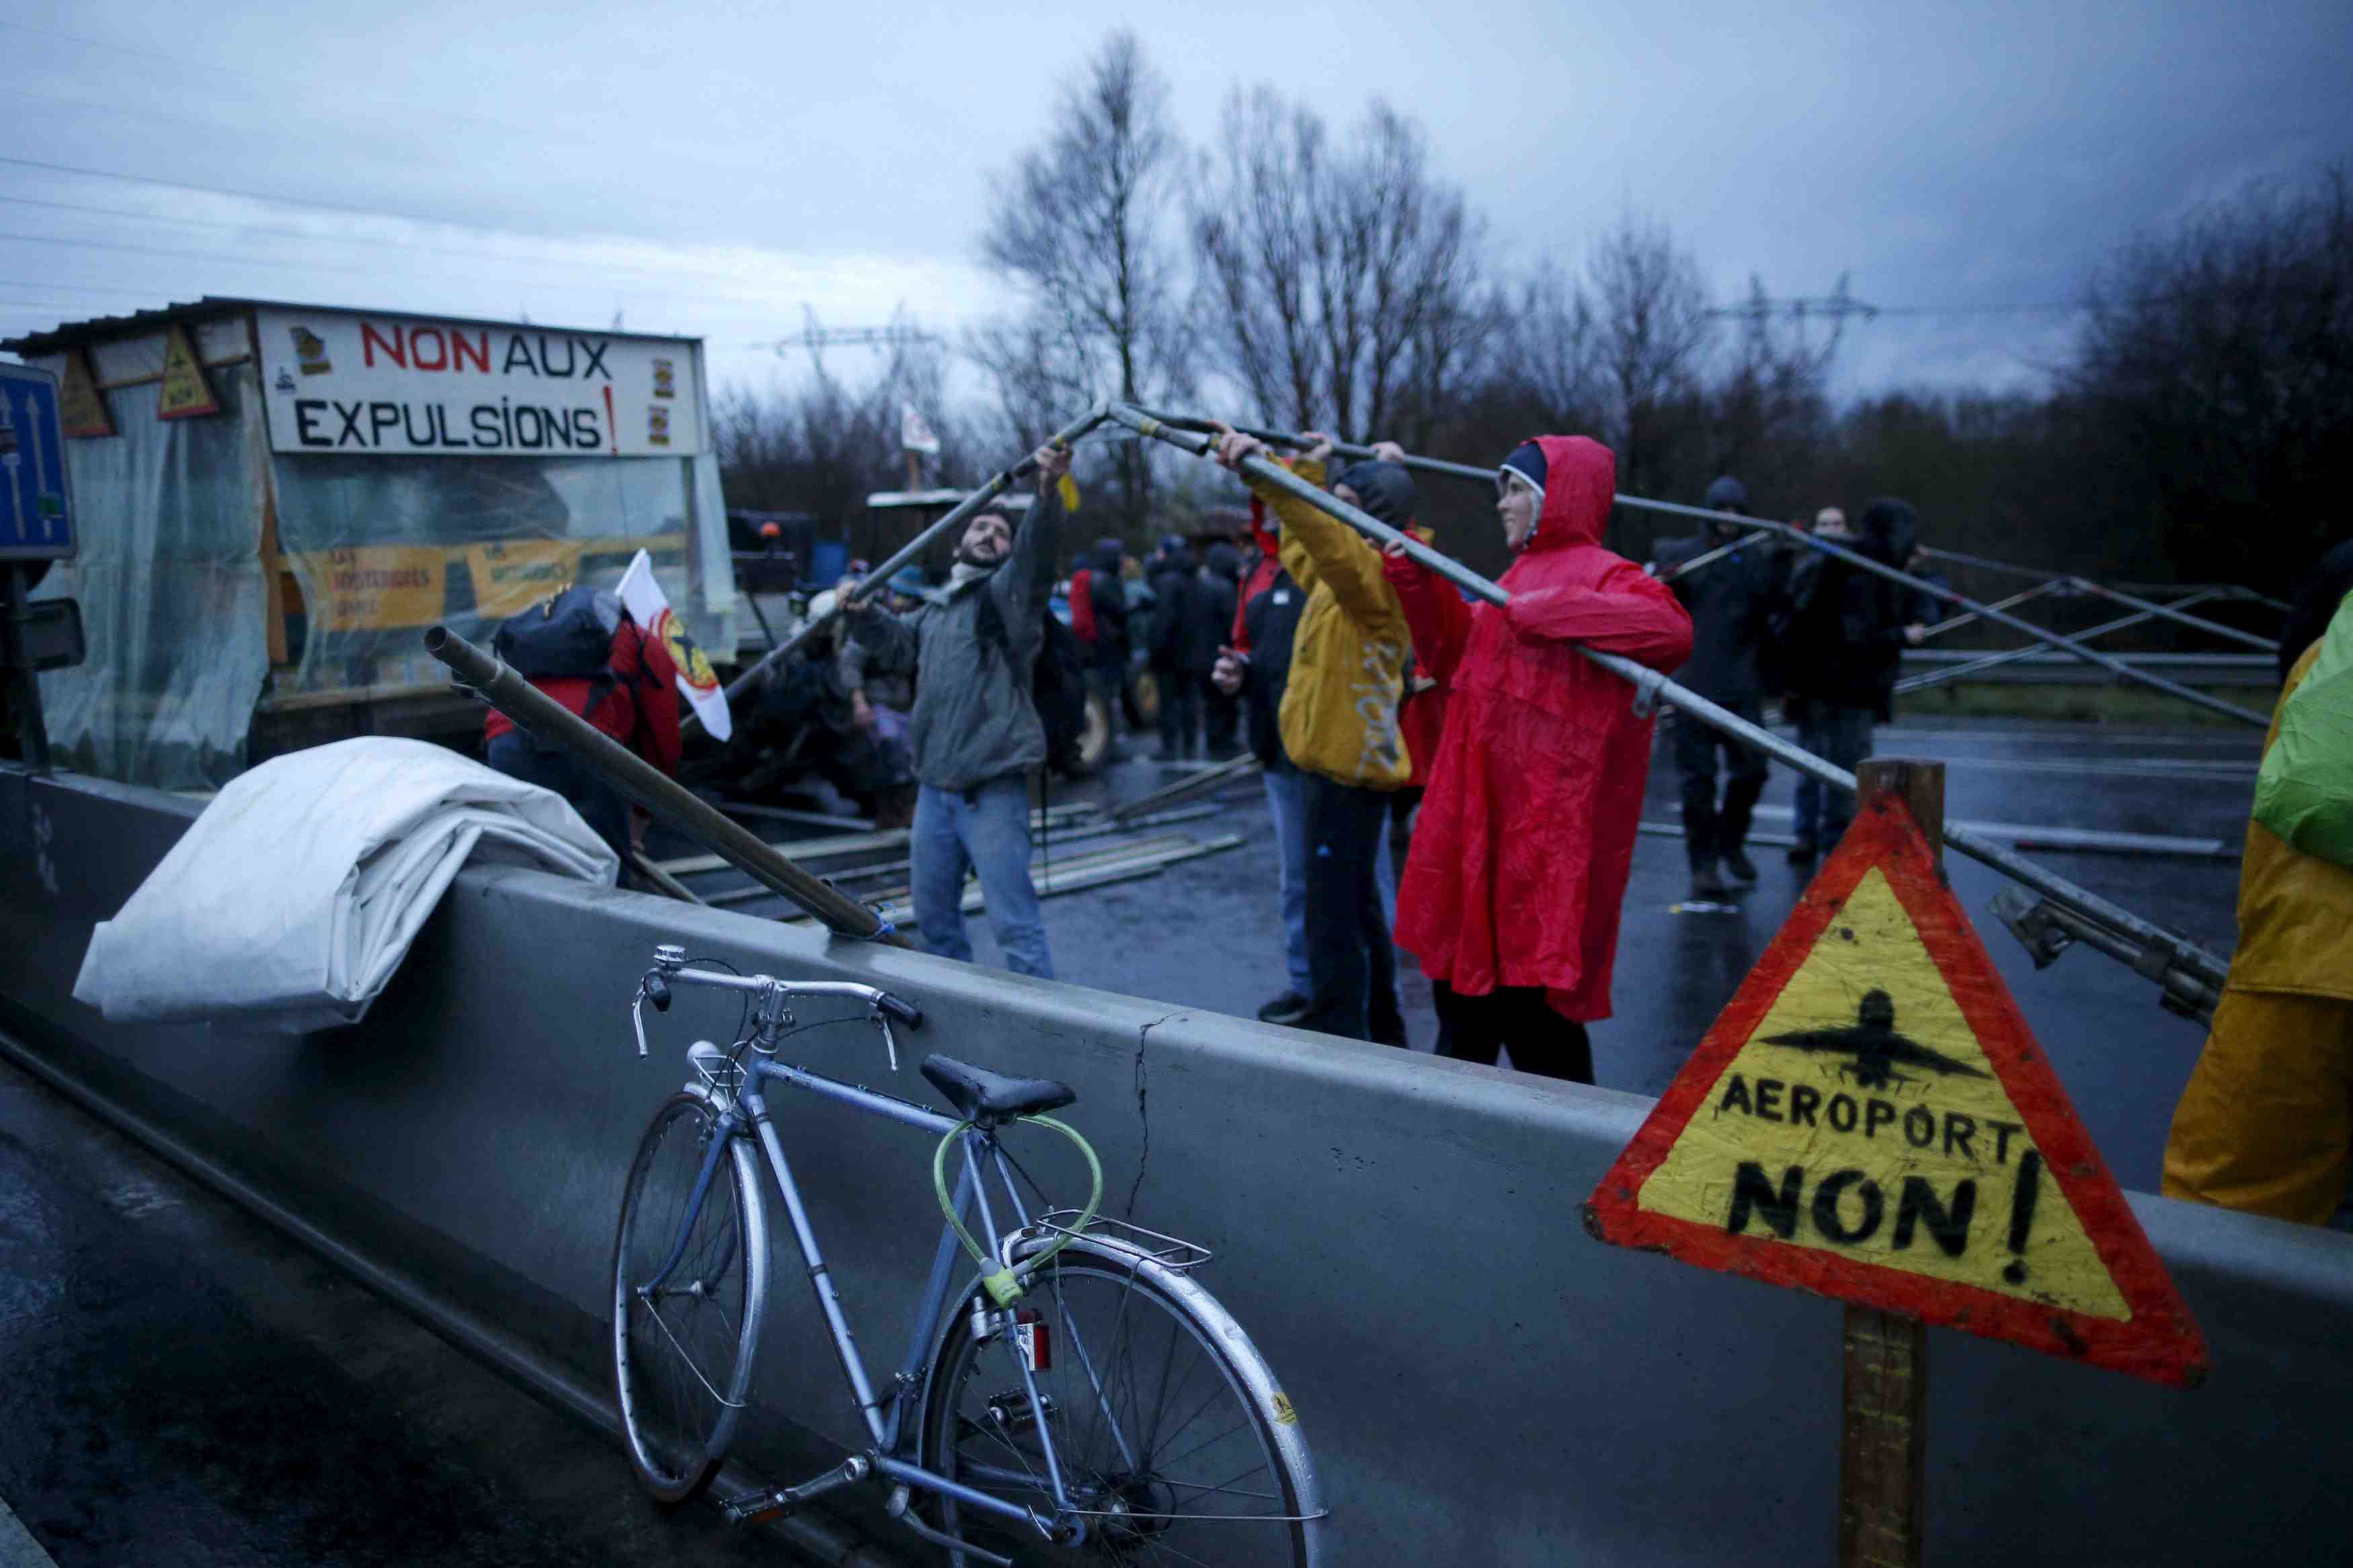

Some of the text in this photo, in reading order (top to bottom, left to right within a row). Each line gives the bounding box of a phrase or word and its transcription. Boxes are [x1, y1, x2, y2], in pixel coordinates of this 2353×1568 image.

[360, 323, 612, 380] NON AUX
[1721, 1075, 2024, 1163] AEROPORT
